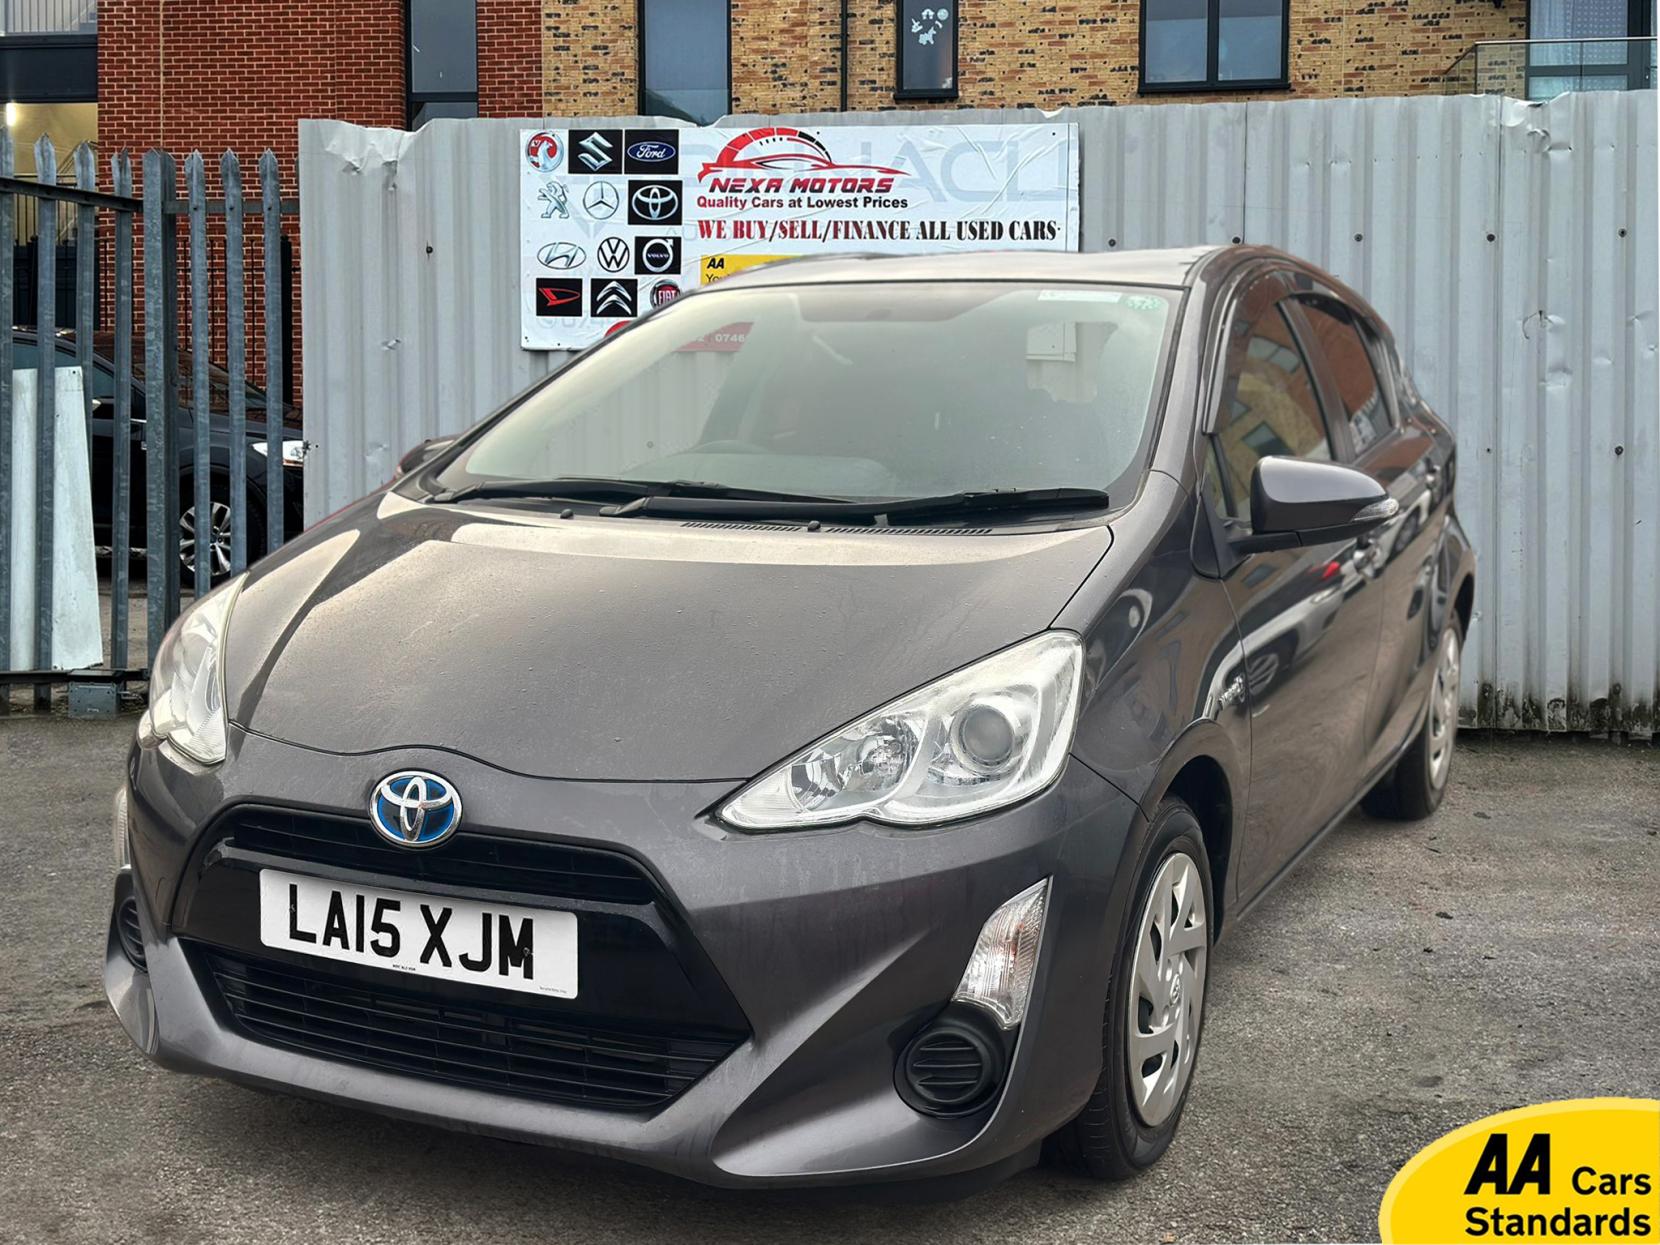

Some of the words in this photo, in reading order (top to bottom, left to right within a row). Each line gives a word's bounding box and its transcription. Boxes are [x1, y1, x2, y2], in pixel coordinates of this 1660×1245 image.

[636, 144, 666, 159] Ford
[709, 178, 784, 193] NEXA
[789, 178, 894, 193] MOTORS
[697, 196, 747, 211] Quality
[751, 197, 784, 208] Cars
[788, 198, 803, 208] at
[807, 196, 858, 208] Lowest
[863, 196, 908, 208] Prices
[697, 220, 727, 239] WE
[732, 220, 910, 242] BUY/SELL/FINANCE
[916, 221, 950, 240] ALL
[956, 221, 1004, 240] USED
[706, 257, 725, 269] AA
[658, 290, 676, 305] FIAT
[289, 883, 401, 958] LA15
[420, 904, 534, 979] XJM
